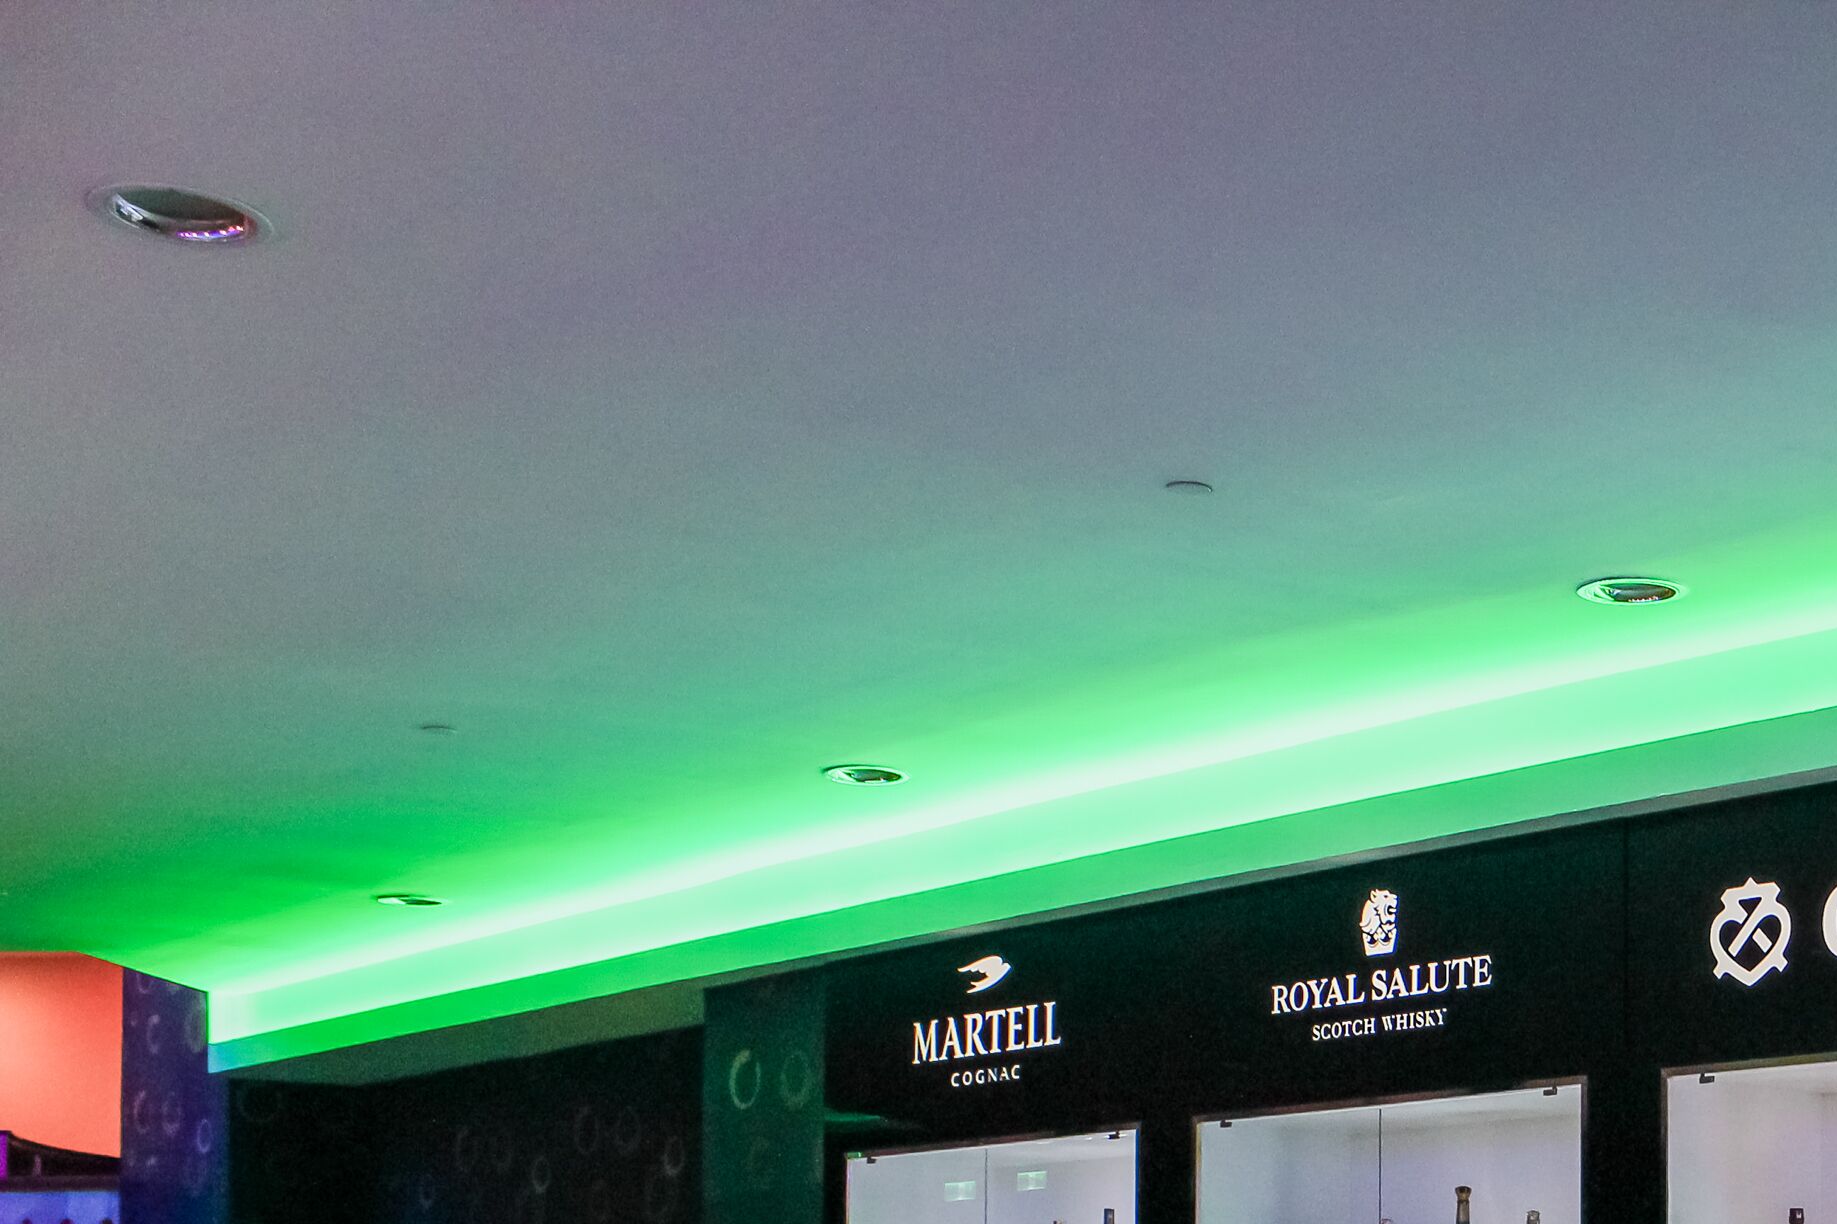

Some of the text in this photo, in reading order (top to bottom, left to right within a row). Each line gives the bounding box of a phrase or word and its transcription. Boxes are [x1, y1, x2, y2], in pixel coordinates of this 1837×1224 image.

[1271, 954, 1493, 1015] ROYAL SALUTE
[911, 1001, 1062, 1065] MARTELL
[1312, 1007, 1448, 1042] SCOTCH WHISKY
[950, 1064, 1021, 1088] COGNAC
